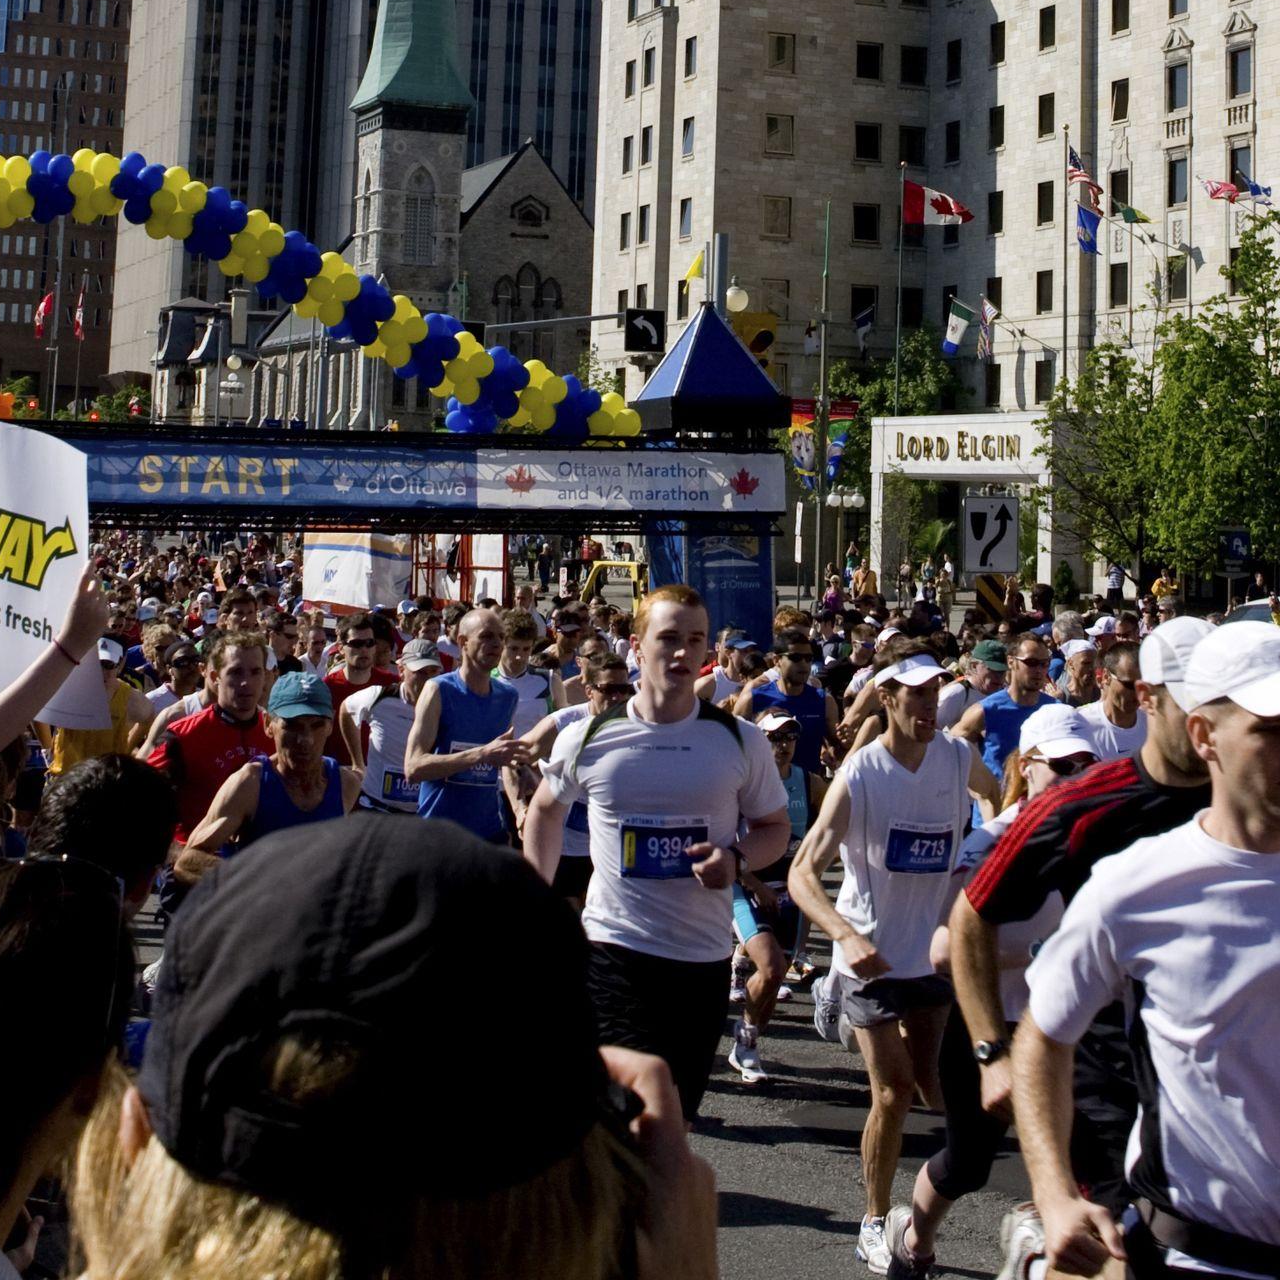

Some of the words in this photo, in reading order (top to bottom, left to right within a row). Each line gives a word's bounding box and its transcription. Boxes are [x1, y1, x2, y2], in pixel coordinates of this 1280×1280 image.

[897, 431, 950, 461] LORD
[957, 430, 1021, 461] ELGIN
[138, 455, 299, 495] START
[557, 461, 621, 477] Ottawa
[626, 462, 708, 479] Marathon
[365, 472, 468, 497] d'Ottawa
[557, 486, 589, 501] and
[596, 485, 624, 501] 1/2
[629, 484, 710, 502] marathon
[910, 839, 945, 857] 4713
